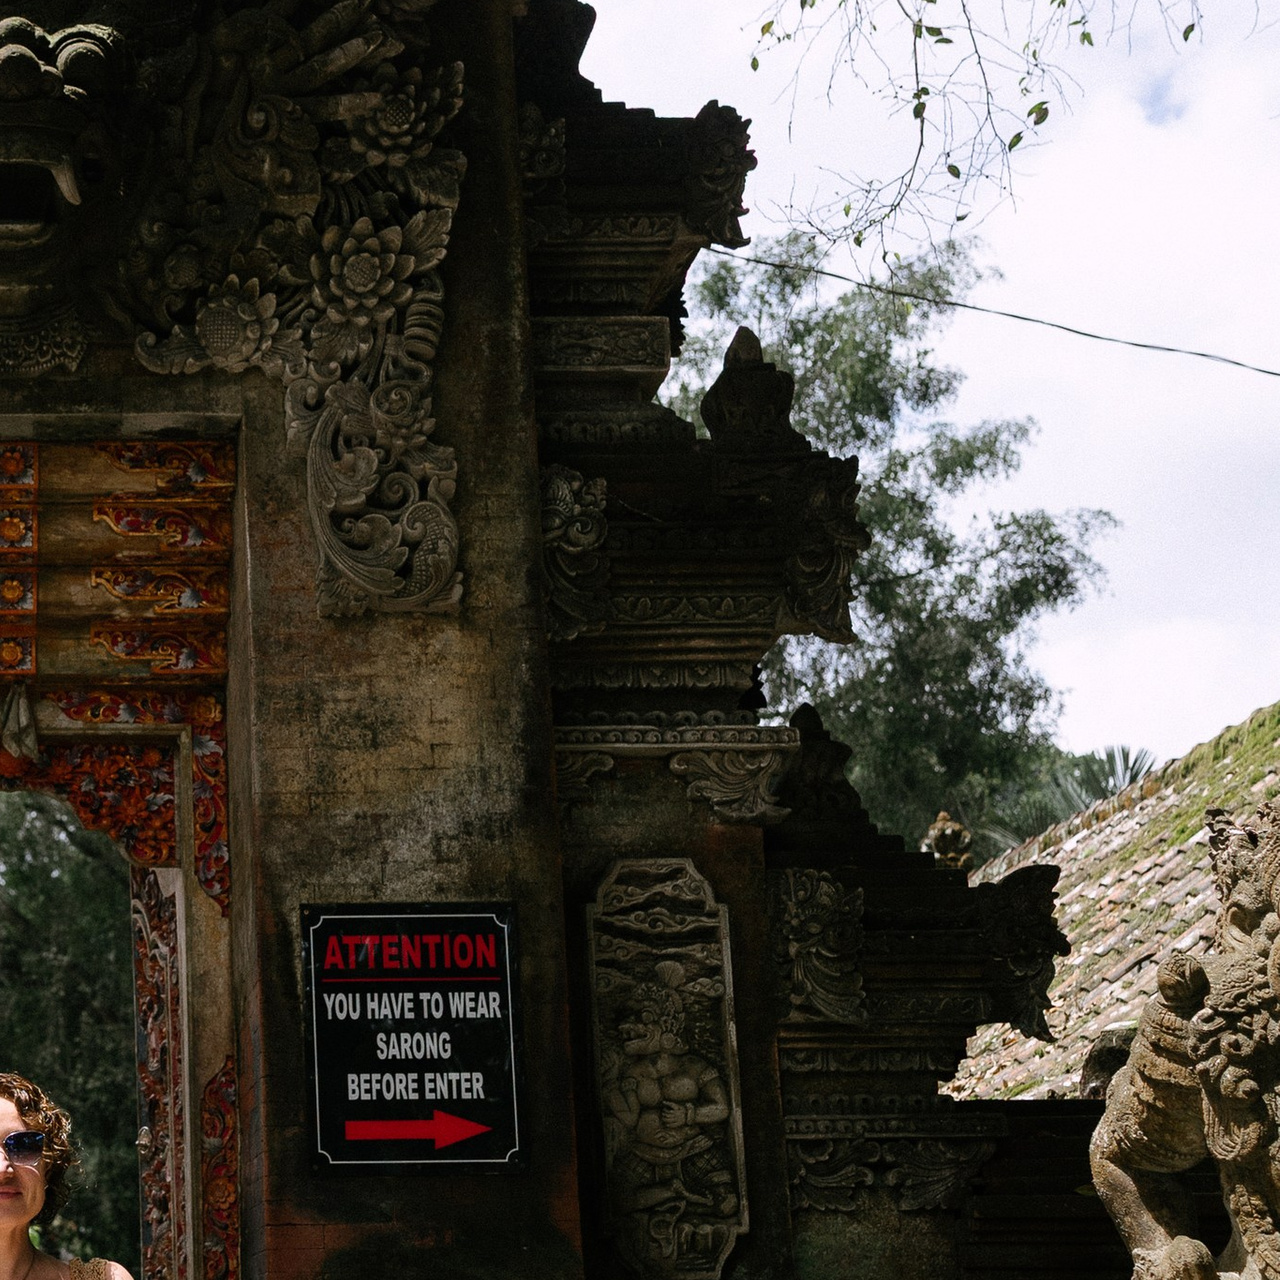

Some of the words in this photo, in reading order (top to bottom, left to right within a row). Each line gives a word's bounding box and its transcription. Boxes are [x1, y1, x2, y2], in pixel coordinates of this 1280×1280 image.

[323, 934, 497, 969] ATTENTION
[323, 992, 361, 1020] YOU
[366, 992, 415, 1019] HAVE
[419, 992, 444, 1019] TO
[448, 991, 502, 1018] WEAR
[376, 1032, 452, 1060] SARONG
[347, 1073, 419, 1100] BEFORE
[424, 1072, 485, 1100] ENTER
